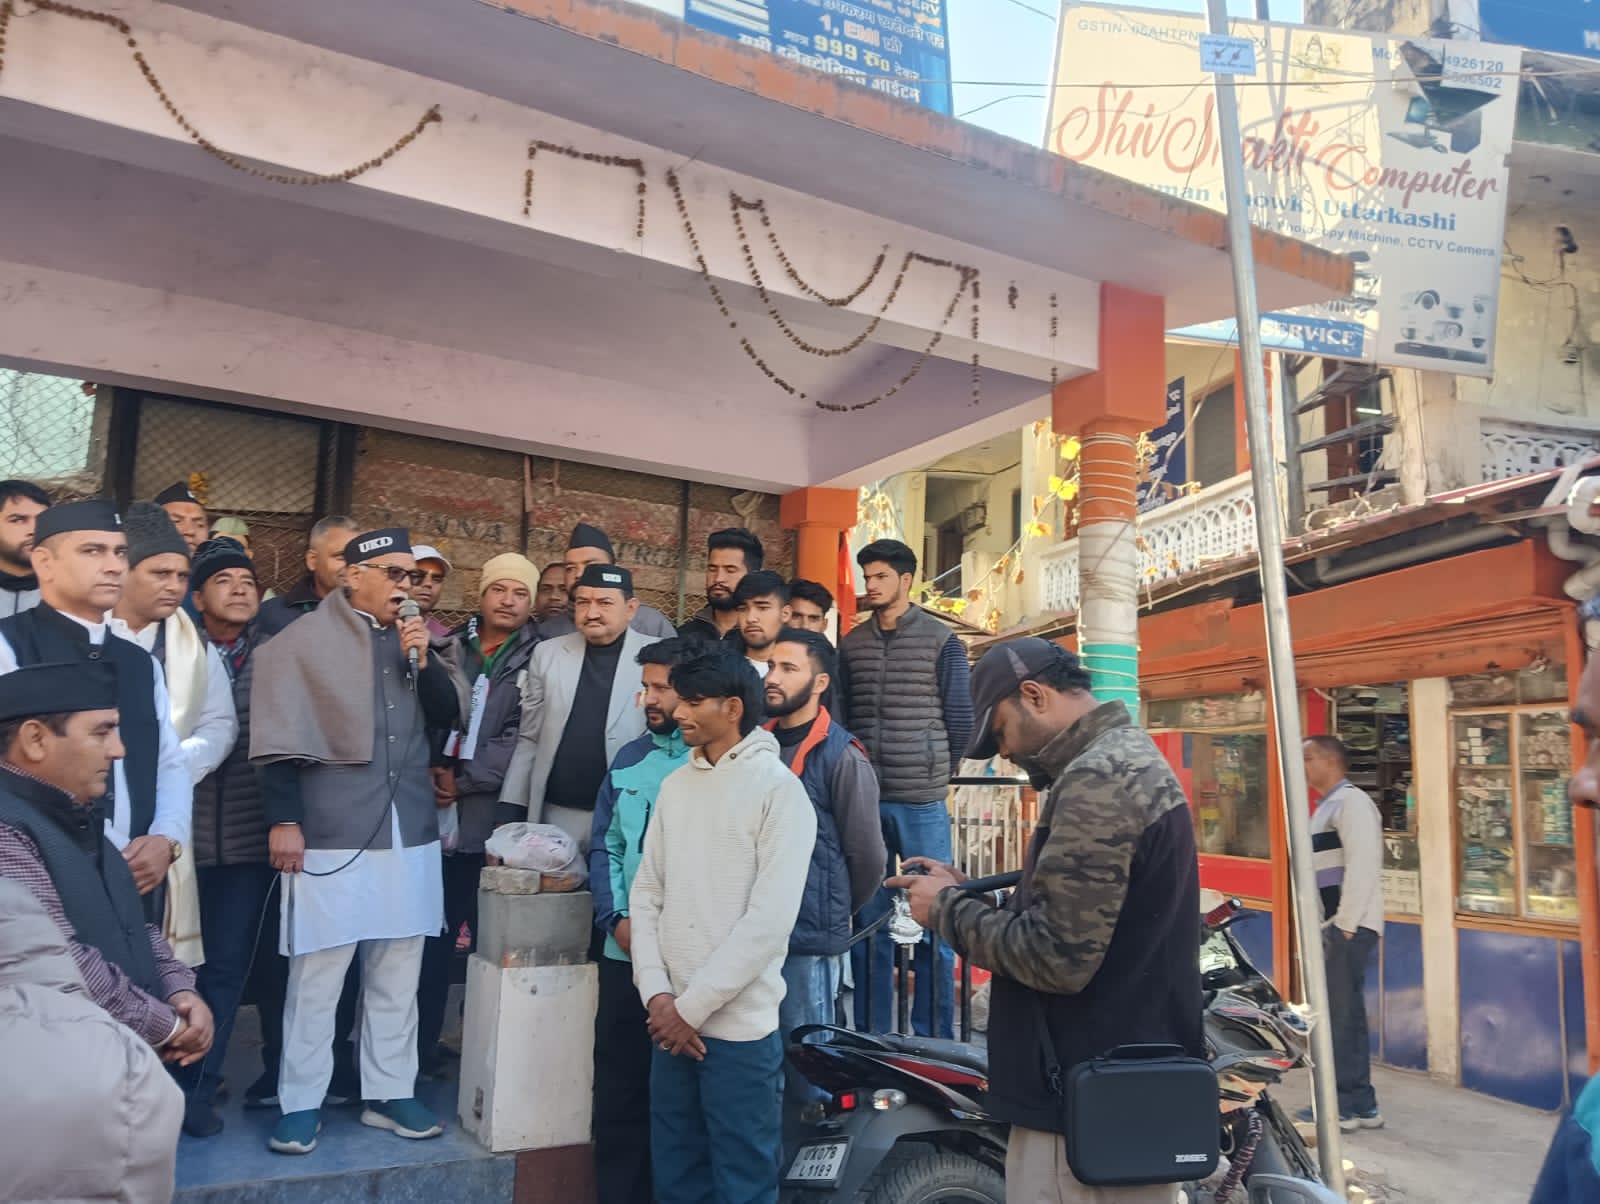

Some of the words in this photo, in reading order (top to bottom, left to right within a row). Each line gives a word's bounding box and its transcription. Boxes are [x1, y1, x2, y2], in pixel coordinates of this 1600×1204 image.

[813, 35, 858, 61] 999
[1314, 143, 1499, 208] Computer
[1323, 199, 1457, 231] Uttarkashi
[1408, 237, 1444, 250] CCTV
[1447, 241, 1496, 257] Camera
[1260, 319, 1358, 346] SERVICE
